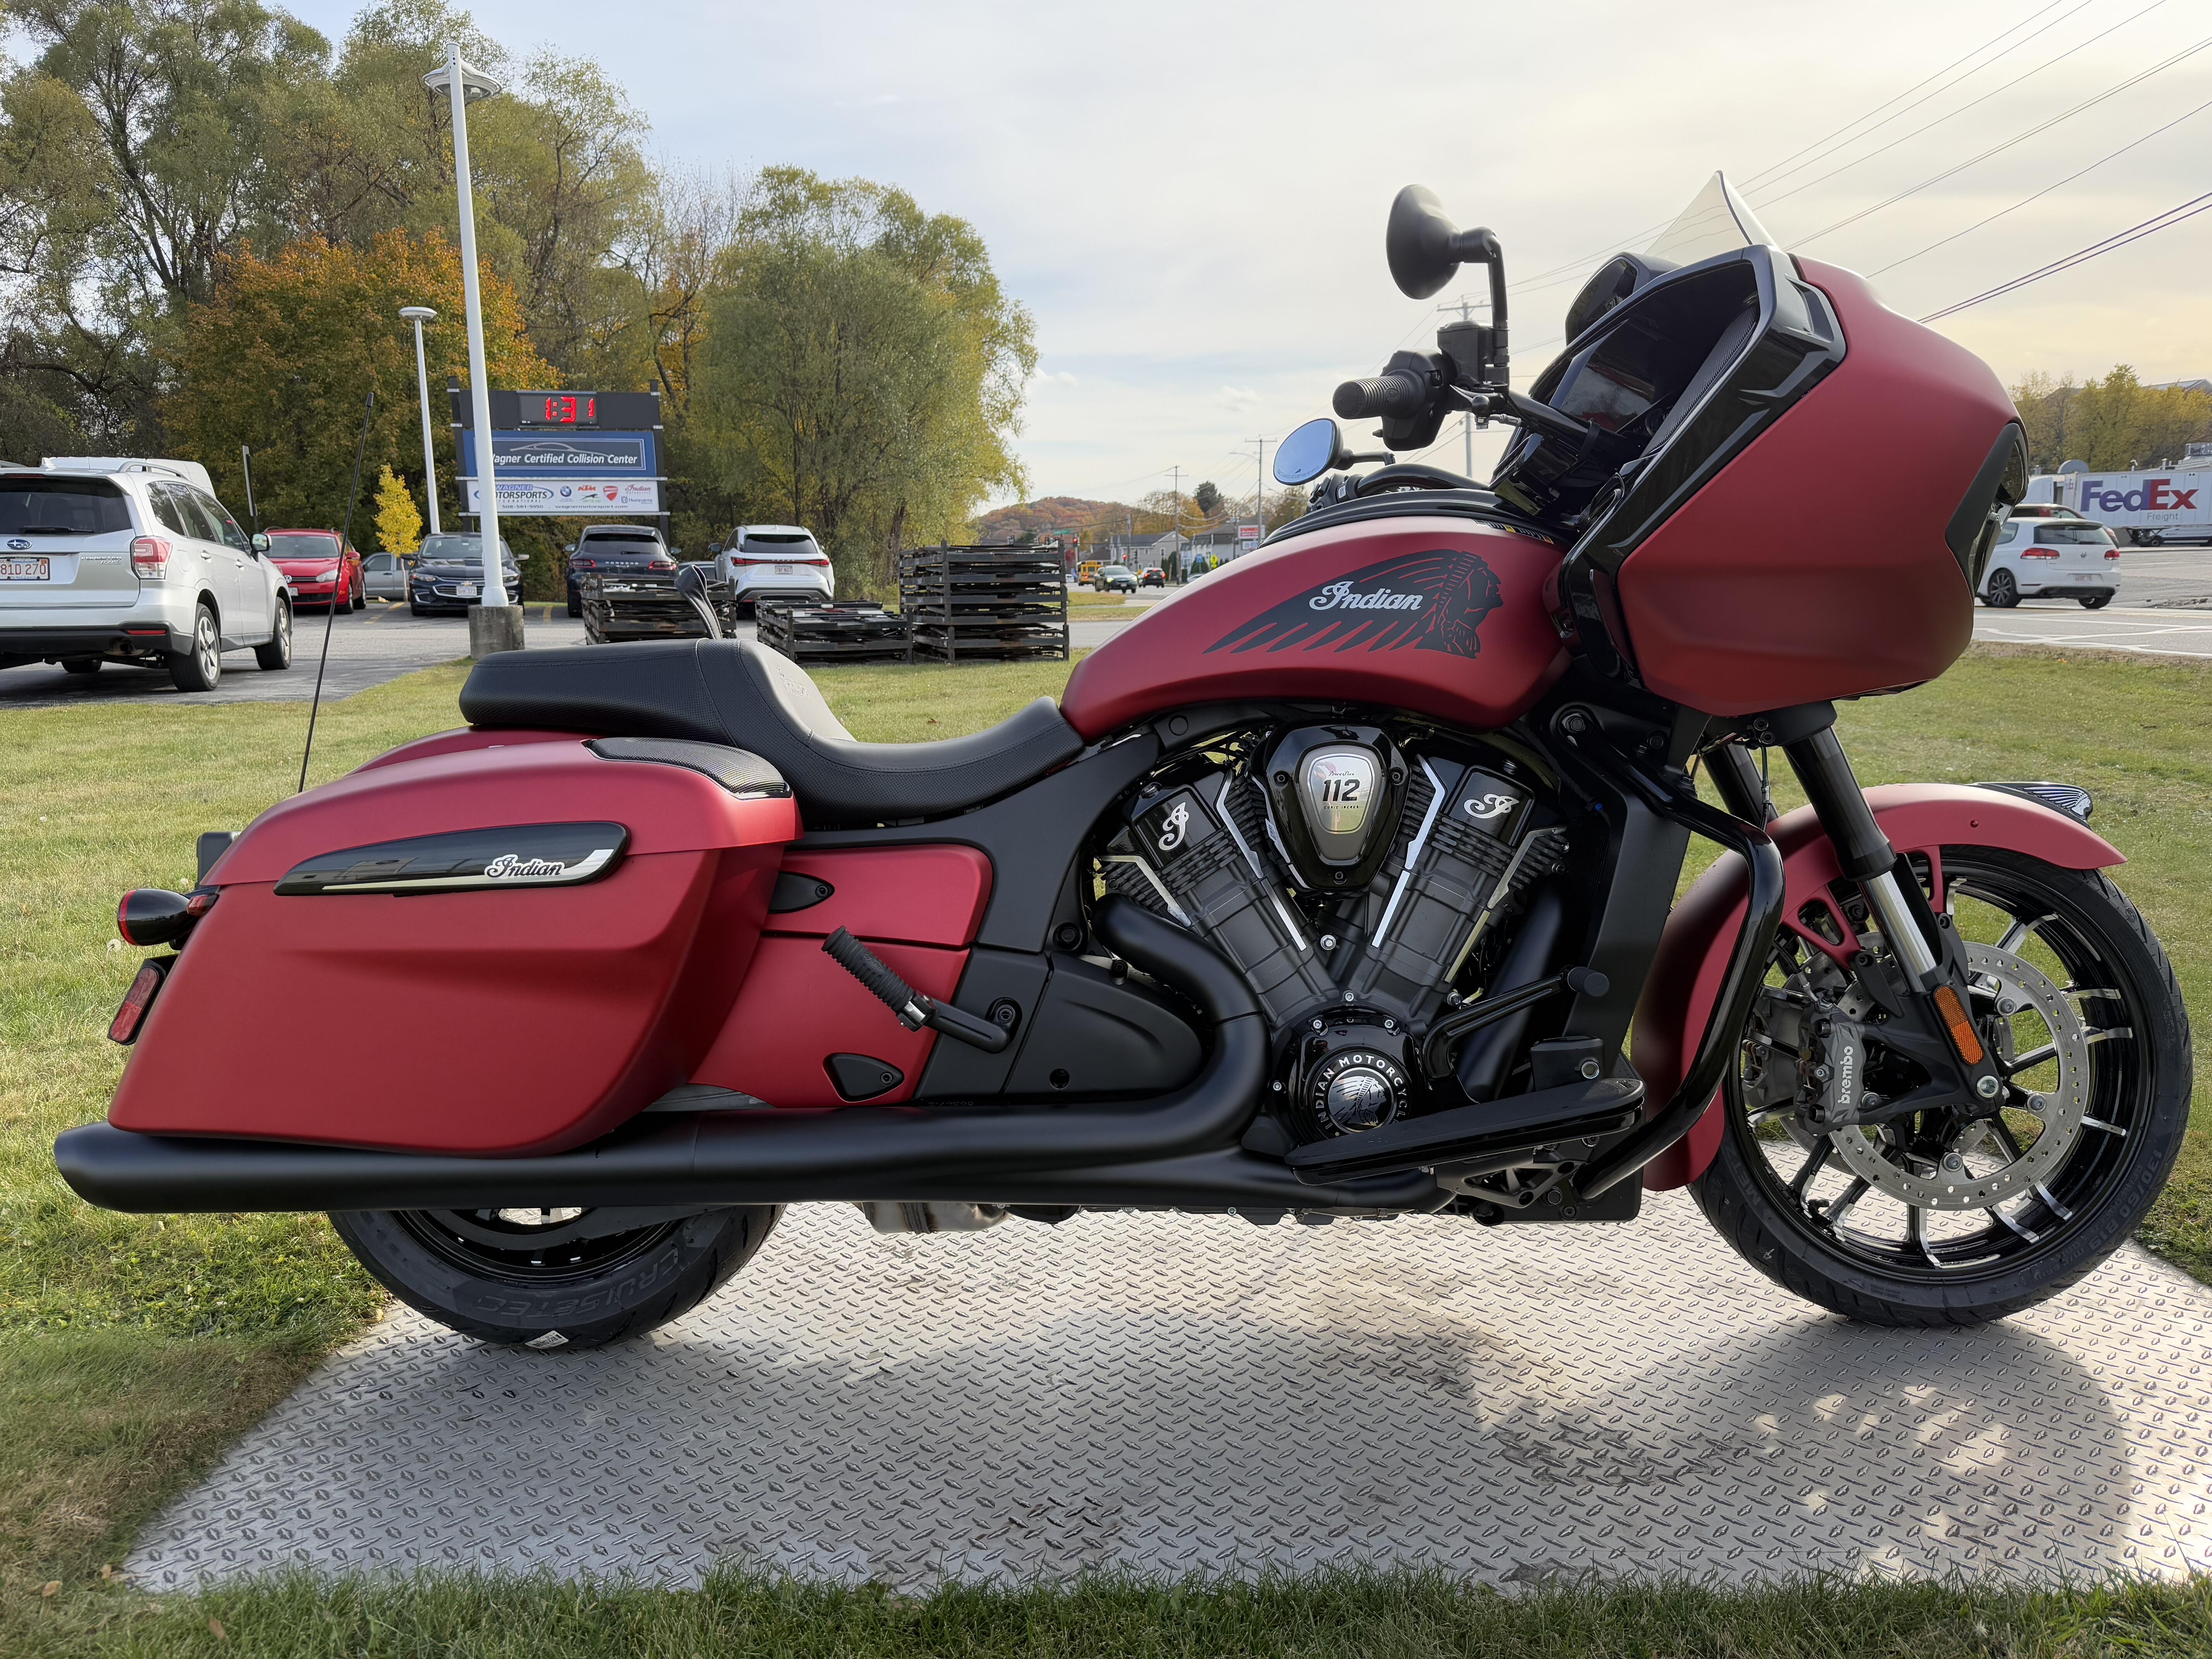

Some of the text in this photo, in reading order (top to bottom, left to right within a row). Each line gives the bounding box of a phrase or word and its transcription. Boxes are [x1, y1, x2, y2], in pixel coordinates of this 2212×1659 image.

[545, 396, 595, 423] 1:31
[524, 453, 564, 464] Certified
[567, 453, 605, 464] Collision
[607, 454, 638, 465] Center
[625, 484, 651, 492] Indian
[2080, 478, 2199, 512] FedEx
[2147, 512, 2178, 521] Freight
[26, 564, 46, 575] 270
[1309, 580, 1424, 611] Indian
[1322, 779, 1360, 801] 112
[486, 855, 563, 879] Indian
[1836, 1045, 1854, 1105] brembo
[1315, 1054, 1407, 1130] INDIAN MOTORCYCL
[2119, 1148, 2163, 1218] 130/60
[476, 1247, 679, 1317] CRUISETEC
